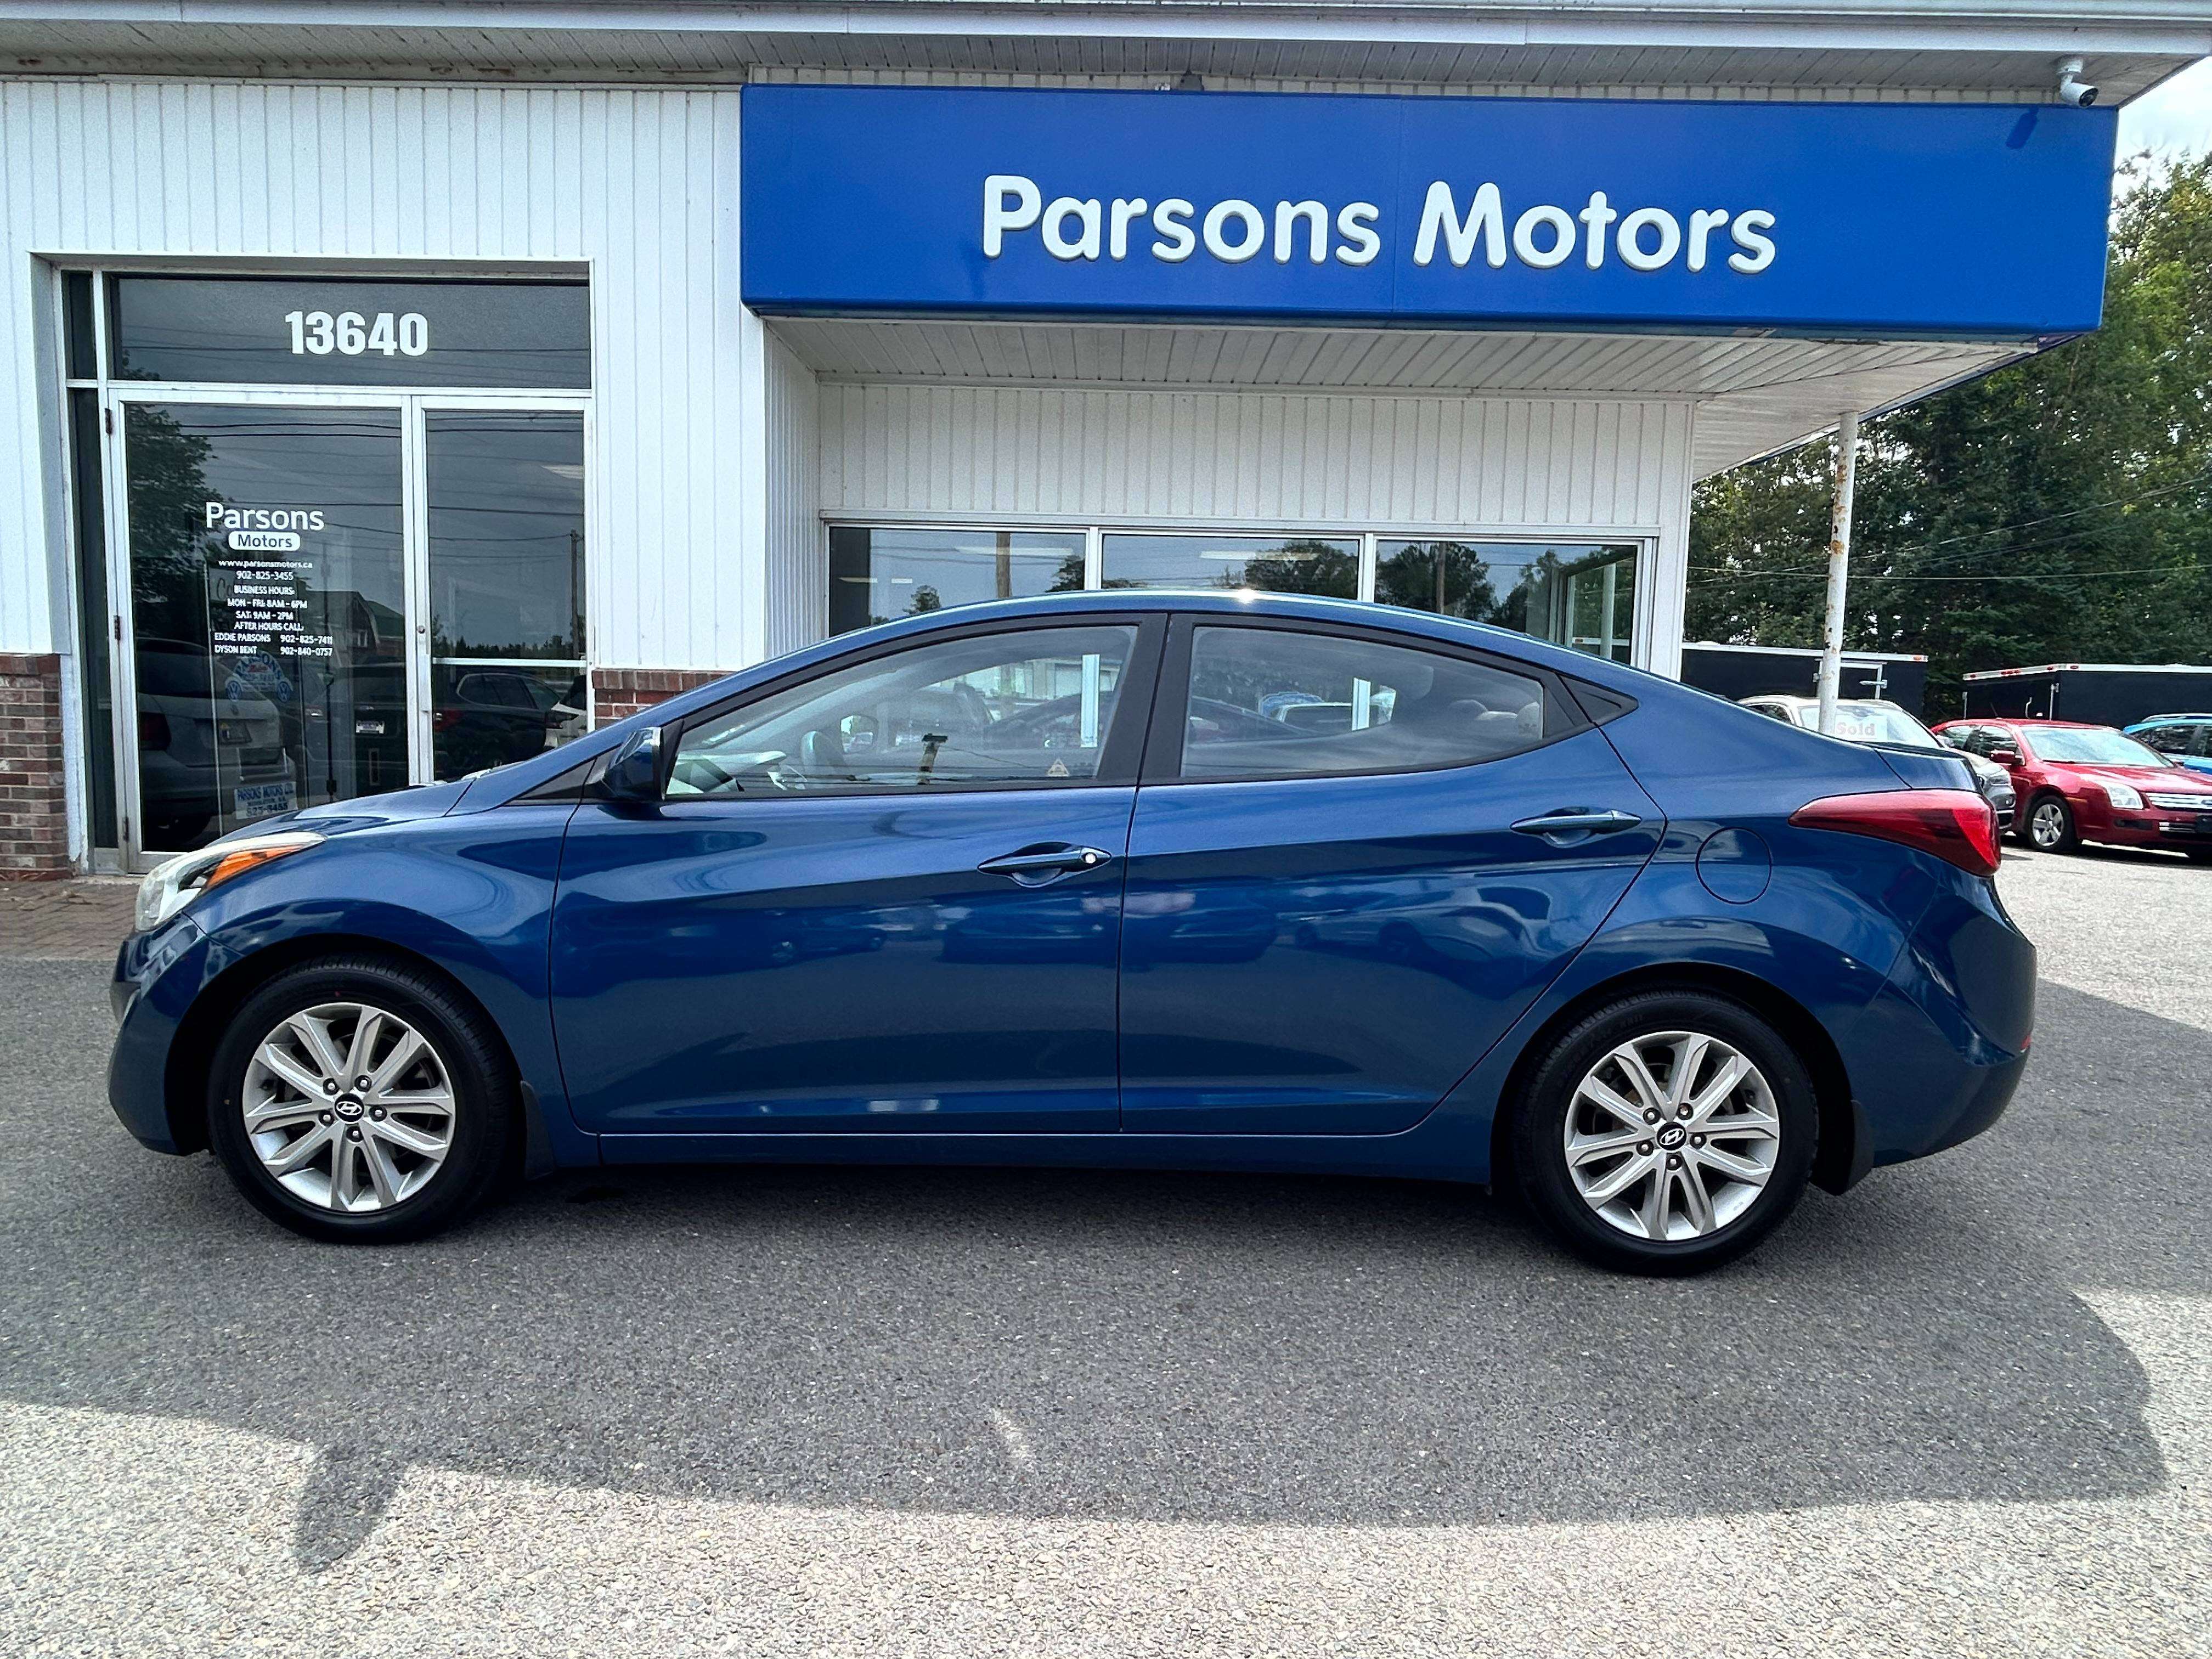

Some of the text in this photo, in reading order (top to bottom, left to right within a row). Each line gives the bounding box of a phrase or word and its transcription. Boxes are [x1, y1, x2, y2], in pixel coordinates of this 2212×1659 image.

[983, 174, 1776, 274] Parsons Motors
[285, 311, 428, 357] 13640
[205, 501, 325, 531] Parsons
[238, 534, 292, 548] Motors
[218, 560, 313, 568] www.parsonsmotors.ca
[236, 571, 294, 580] 902-825-3455
[234, 585, 267, 594] BUSINESS
[227, 598, 246, 607] MON
[252, 611, 271, 620] 9AM
[277, 612, 294, 620] 2PM
[234, 622, 257, 630] AFTER
[258, 622, 283, 631] HOURS
[214, 633, 237, 641] EDDIE
[237, 633, 271, 642] PARSONS
[214, 645, 239, 653] DYSON
[1836, 722, 1875, 736] Sold
